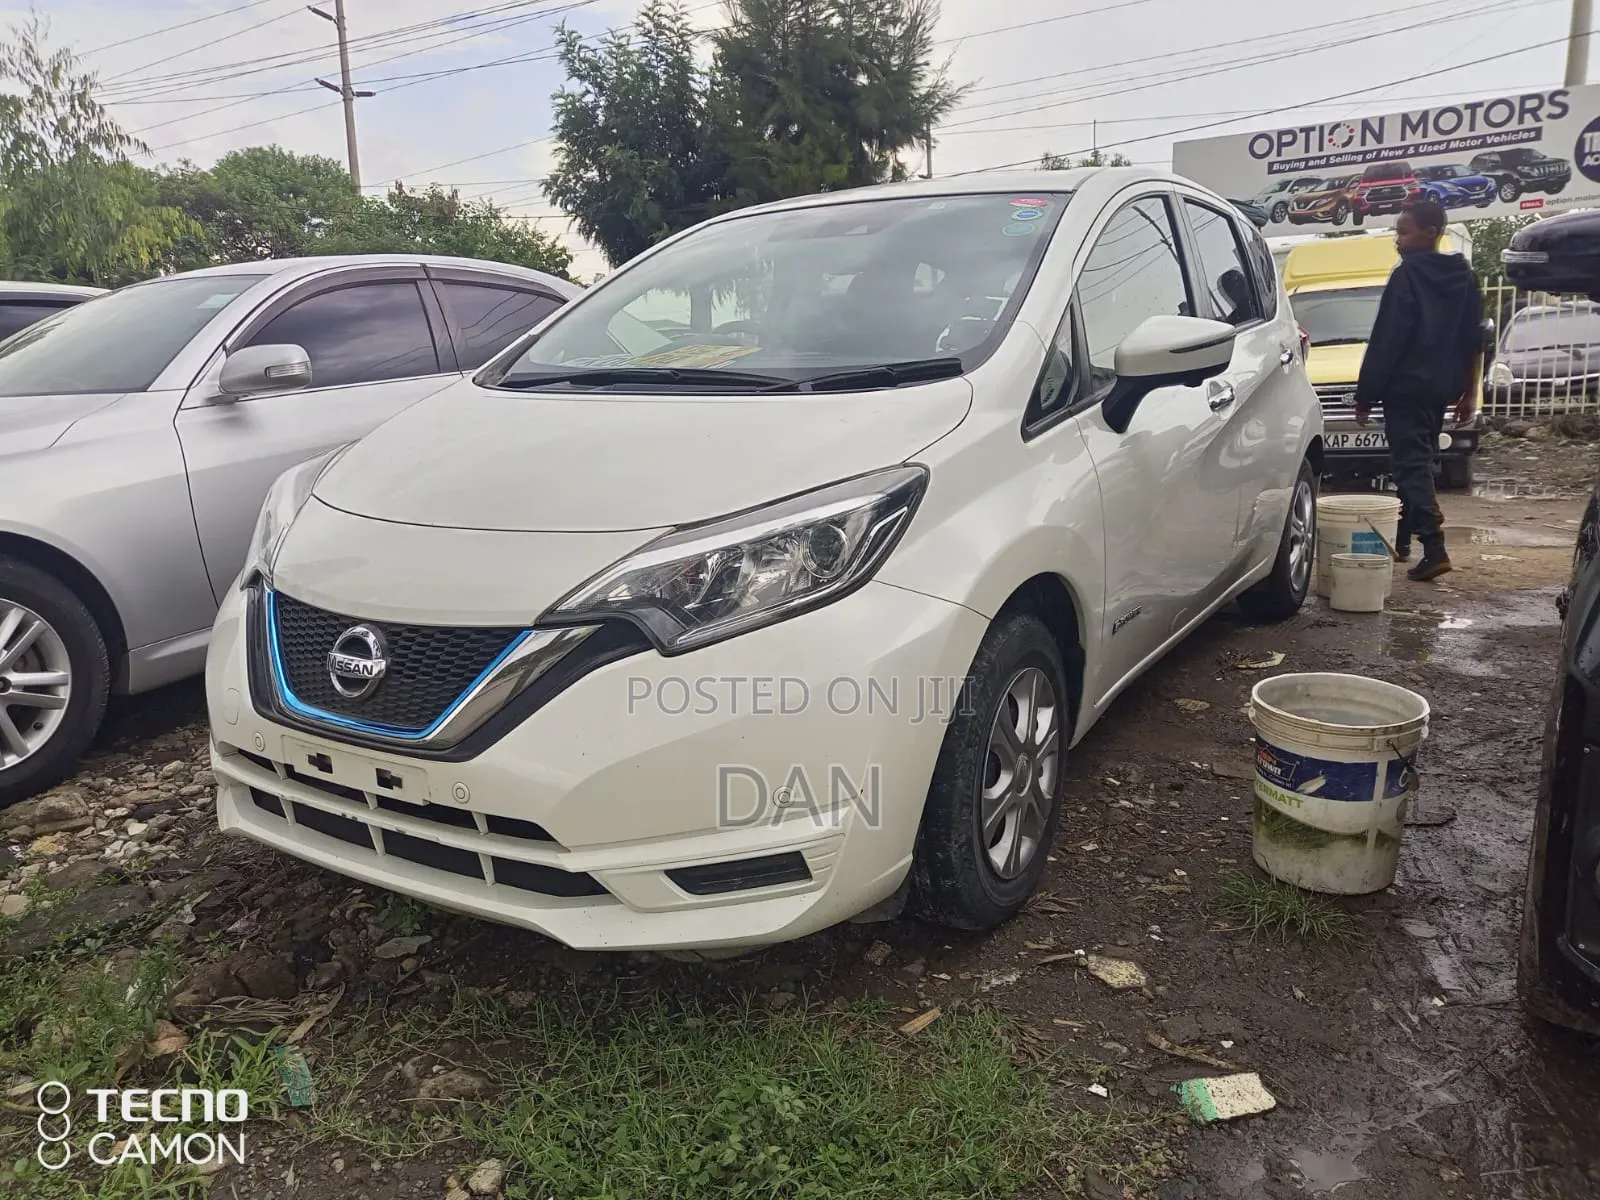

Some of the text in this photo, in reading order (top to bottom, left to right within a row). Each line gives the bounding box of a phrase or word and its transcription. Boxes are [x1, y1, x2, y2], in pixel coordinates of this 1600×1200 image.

[1248, 89, 1570, 160] OPTION MOTORS
[1272, 131, 1537, 172] Buying and Selling of New & Used Motor Vehicles
[1323, 433, 1350, 448] KAP
[327, 653, 374, 676] NISSAN
